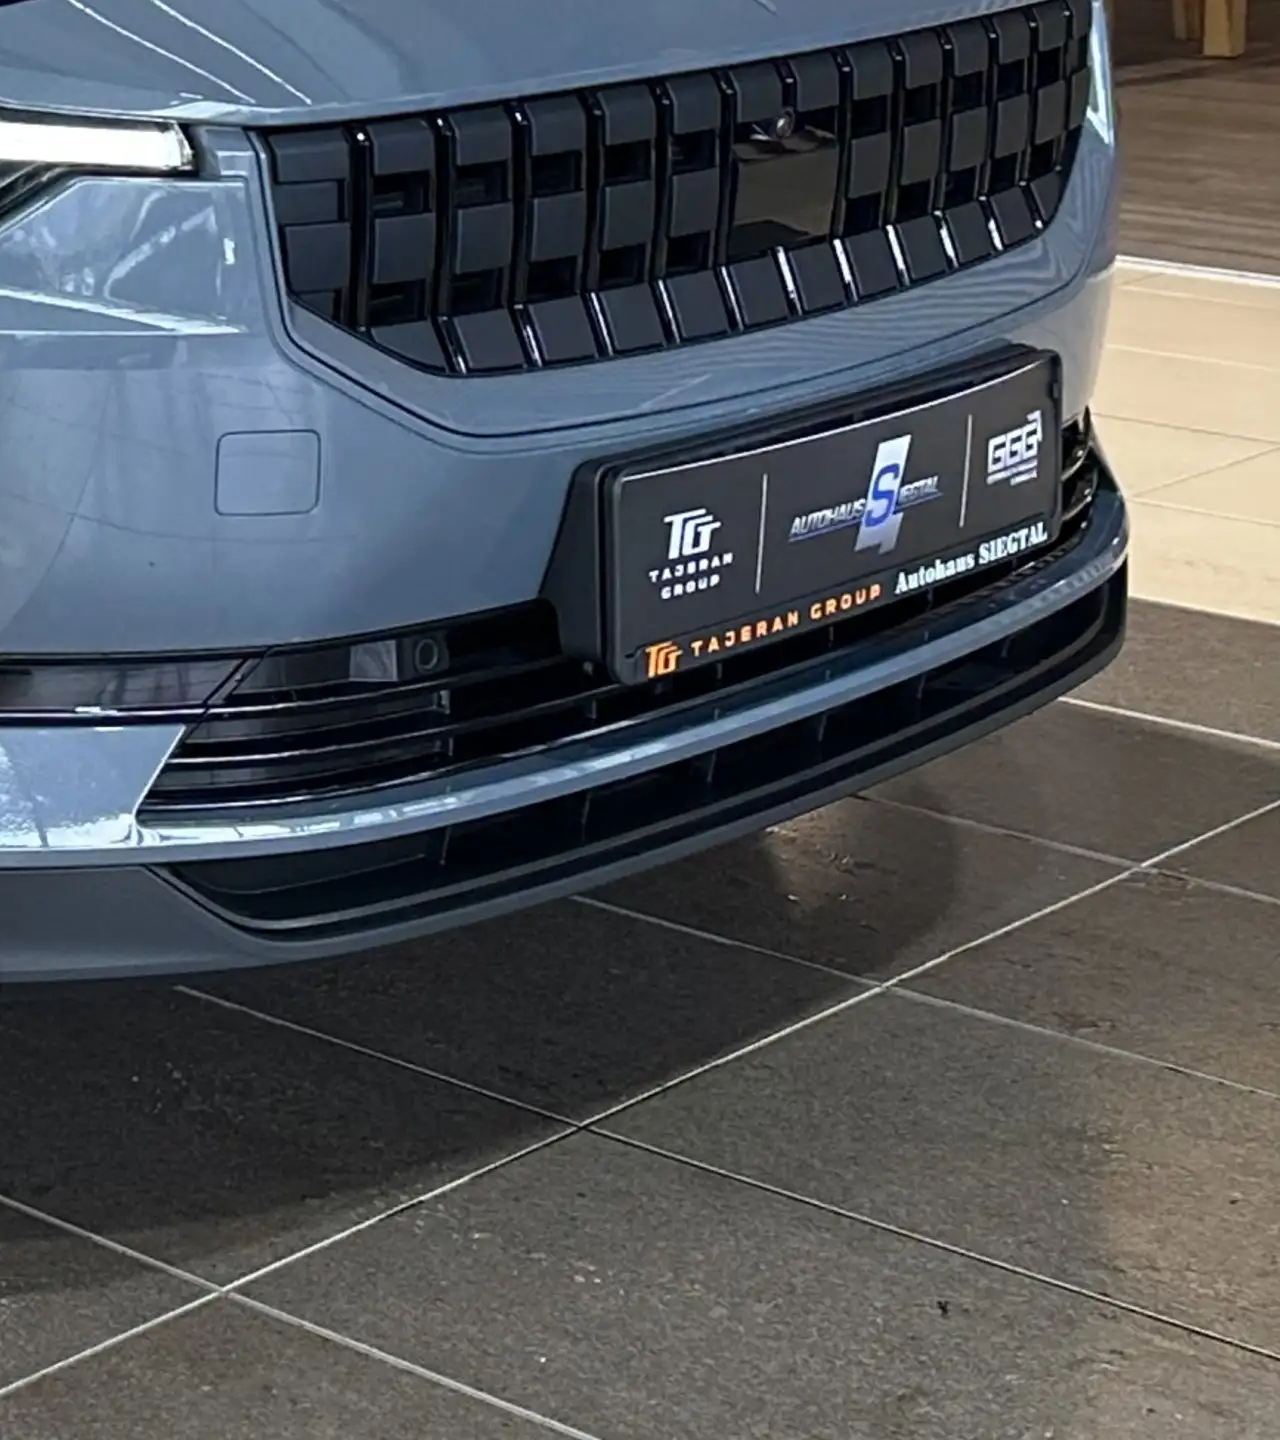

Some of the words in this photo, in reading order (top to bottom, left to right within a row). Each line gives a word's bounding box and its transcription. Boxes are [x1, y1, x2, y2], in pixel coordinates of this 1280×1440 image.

[791, 497, 867, 535] AUTOHAUS
[648, 552, 734, 584] TAJERAN
[894, 552, 976, 595] Autohaus
[977, 521, 1049, 566] SIEGTAL
[660, 573, 721, 601] GROUP
[690, 610, 800, 658] TAJERAN
[809, 583, 882, 621] GROUP
